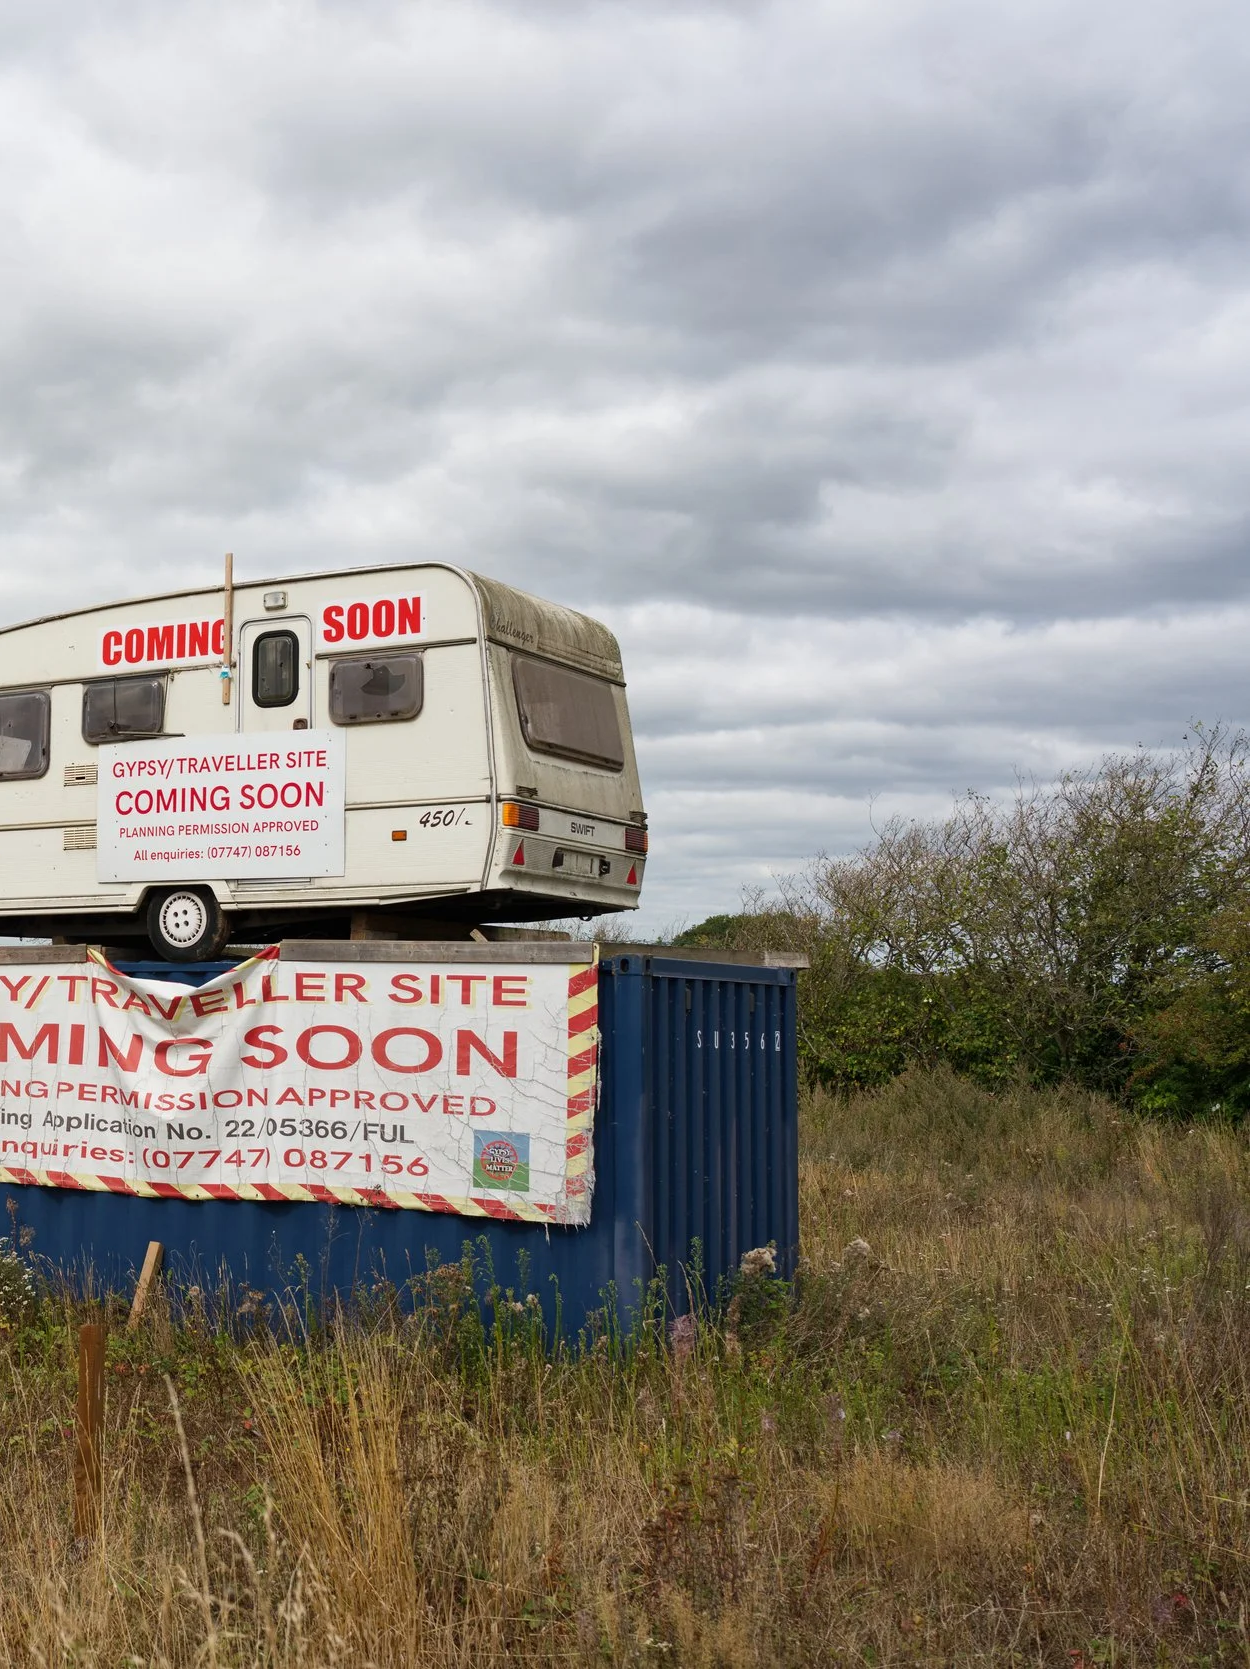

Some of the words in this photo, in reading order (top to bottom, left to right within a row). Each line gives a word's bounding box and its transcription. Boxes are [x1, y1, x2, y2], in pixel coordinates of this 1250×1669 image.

[323, 597, 421, 642] SOON
[112, 753, 280, 779] GYPSY/TRAVELLER
[286, 750, 327, 768] SITE
[115, 786, 230, 815] COMING
[239, 781, 324, 809] SOON
[119, 825, 175, 839] PLANNING
[178, 822, 249, 836] PERMISSION
[253, 820, 319, 833] APPROVED
[570, 822, 596, 837] SWIFT
[134, 849, 148, 861] All
[151, 849, 204, 863] enquiries:
[207, 846, 252, 859] (07747)
[255, 845, 301, 857] 087156
[388, 973, 530, 1007] SITE
[241, 1024, 517, 1078] SOON
[56, 1079, 268, 1110] PERMISSION
[276, 1087, 497, 1117] APPROVED
[42, 1109, 156, 1139] Application
[167, 1123, 211, 1140] No.
[225, 1118, 414, 1145] 22/05366/FUL
[142, 1147, 270, 1170] (07747)
[283, 1148, 429, 1177] 087156
[486, 1164, 513, 1172] MATTER
